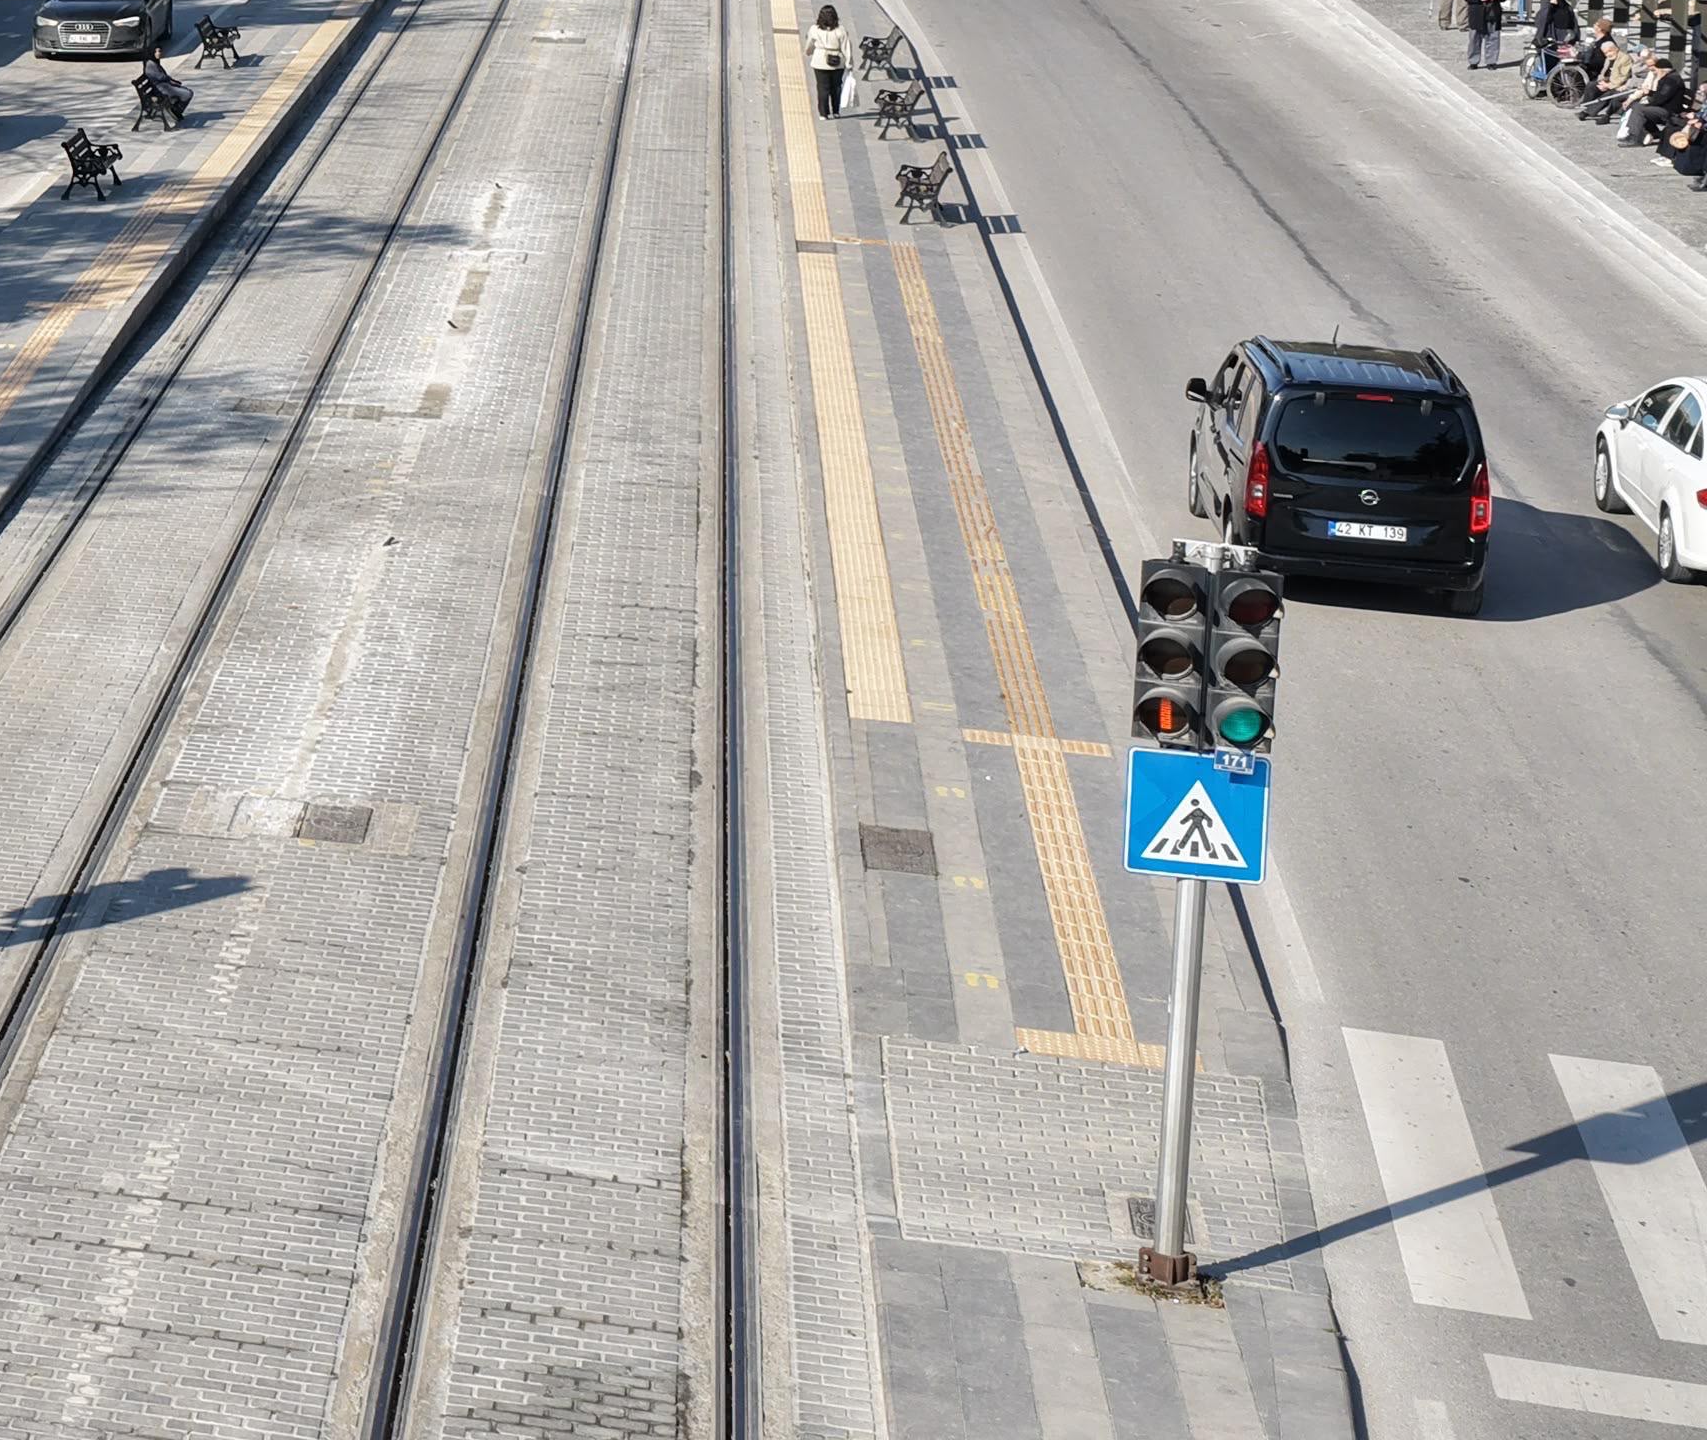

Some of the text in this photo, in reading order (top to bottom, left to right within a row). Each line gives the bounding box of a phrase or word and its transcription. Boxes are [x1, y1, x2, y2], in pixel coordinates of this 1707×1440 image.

[1337, 523, 1405, 540] 42 KT 139
[1222, 753, 1248, 769] 171
